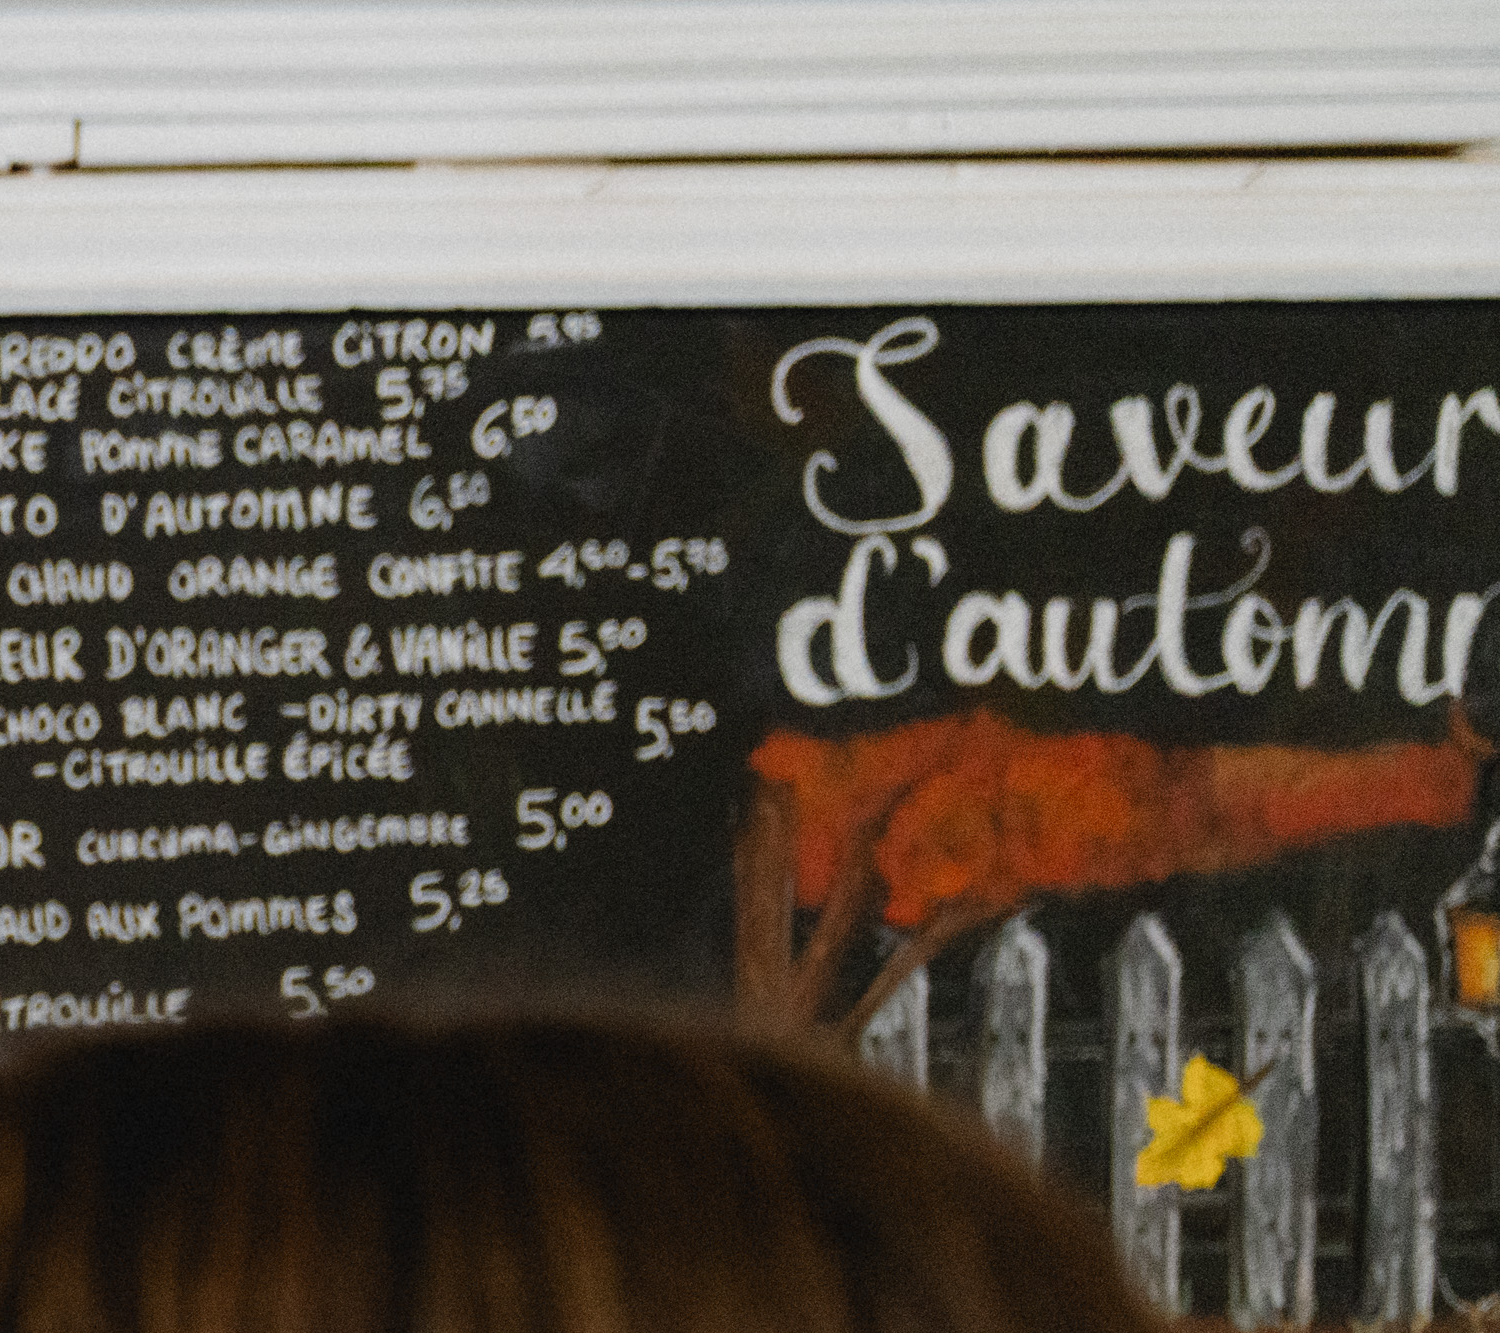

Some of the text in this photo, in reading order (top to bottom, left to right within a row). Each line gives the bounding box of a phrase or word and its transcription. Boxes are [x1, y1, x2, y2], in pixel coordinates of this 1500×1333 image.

[332, 318, 495, 369] CITRON
[81, 429, 223, 473] POMME
[234, 420, 432, 466] CARAMEL
[102, 482, 378, 539] D'AUTOMNE
[7, 559, 134, 606] CHAUD
[168, 553, 340, 600] ORANGE
[367, 549, 526, 599] CONFITE
[106, 626, 332, 682] D'ORANGER
[390, 619, 539, 678] VANILLE
[120, 692, 247, 738] BLANC
[434, 680, 618, 730] CANNELLE
[86, 900, 161, 943] AUX
[178, 890, 358, 941] POMMES
